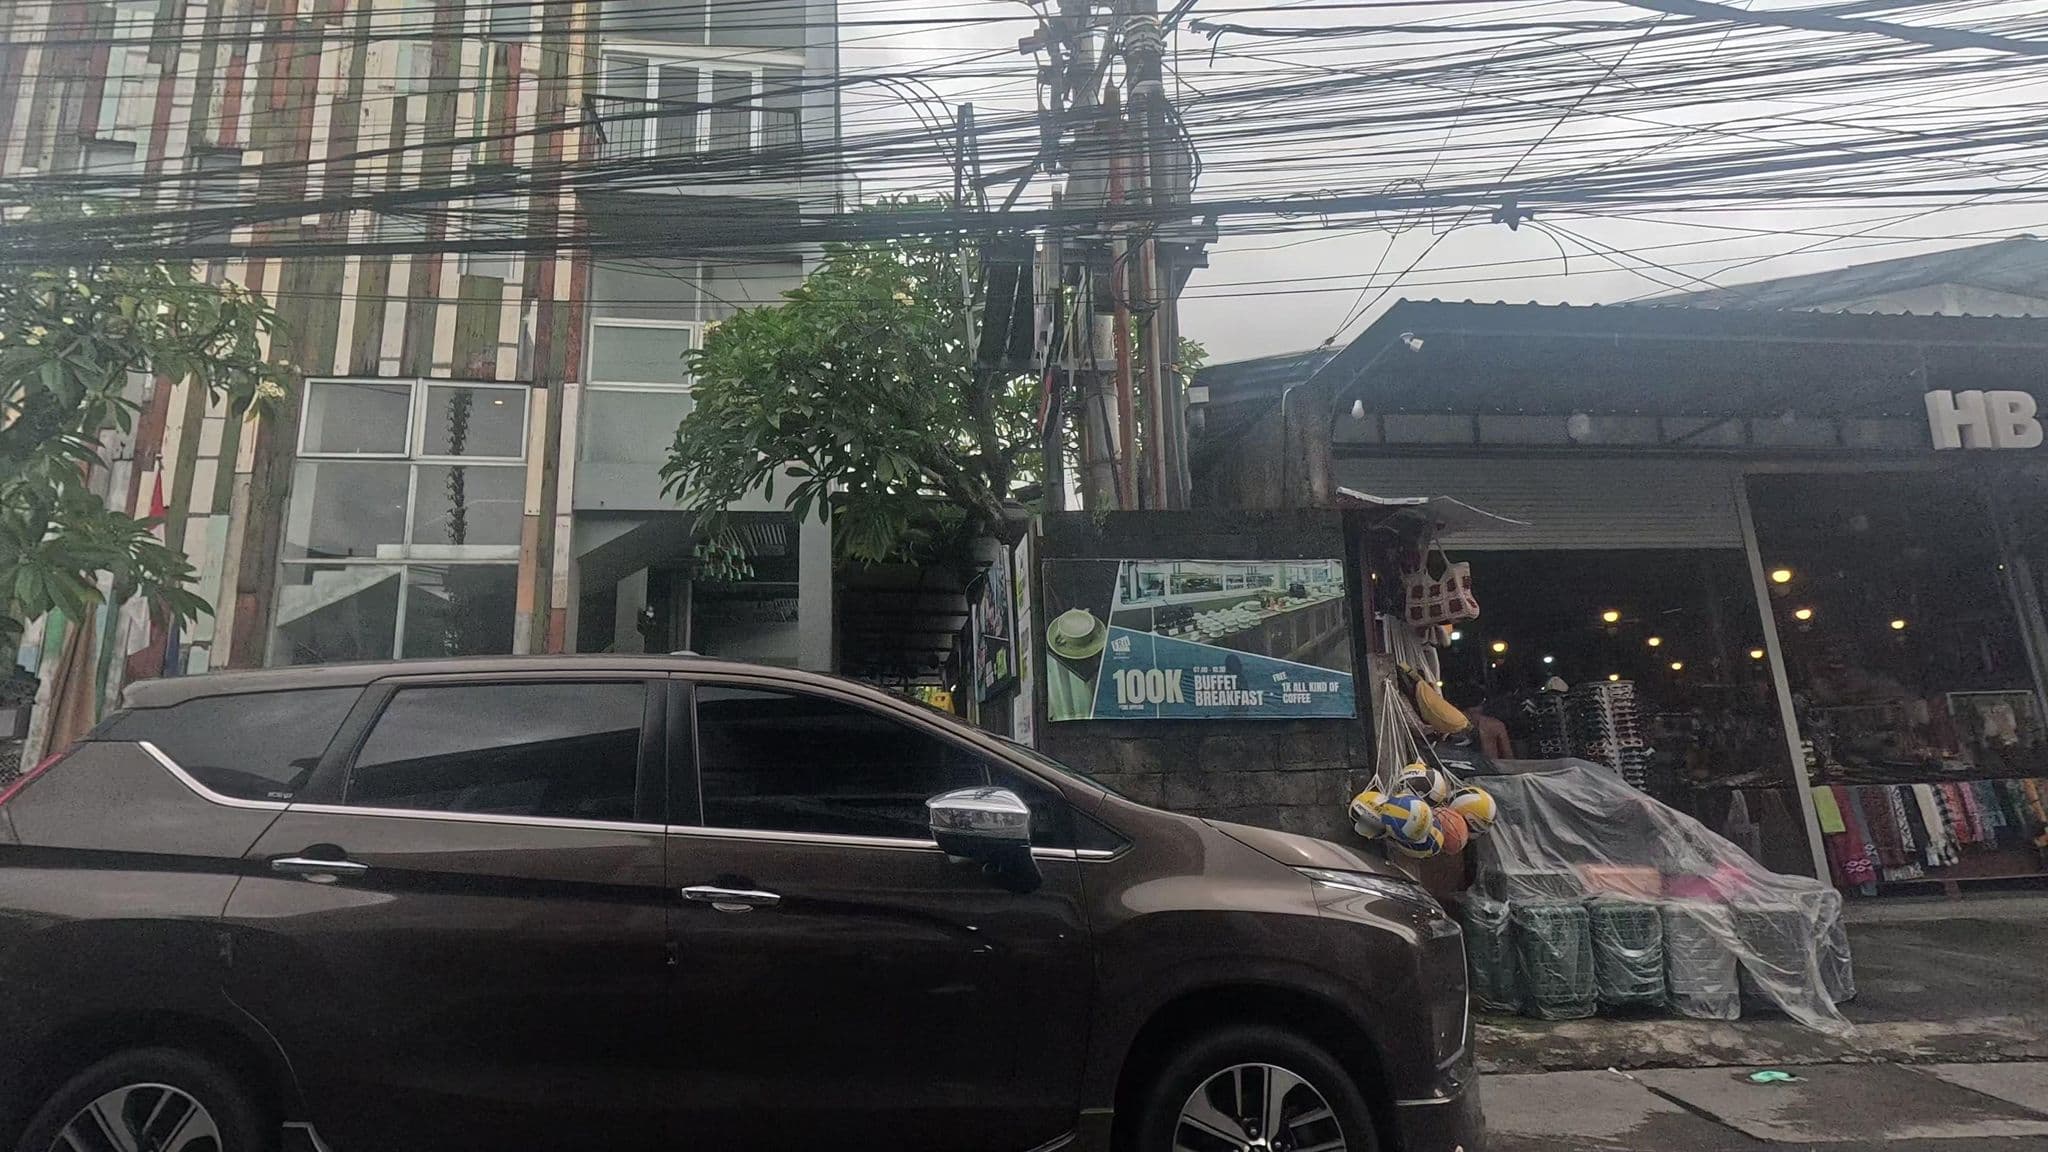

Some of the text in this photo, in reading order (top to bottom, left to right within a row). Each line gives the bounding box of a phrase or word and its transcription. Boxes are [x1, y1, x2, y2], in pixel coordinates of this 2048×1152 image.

[1924, 389, 2044, 450] HB
[1112, 668, 1185, 704] 100K
[1194, 674, 1238, 690] BUFFET
[1293, 682, 1308, 692] ALL
[1309, 682, 1328, 692] KIND
[1329, 682, 1340, 693] OF
[1195, 690, 1264, 706] BREAKFAST
[1283, 693, 1312, 704] COFFEE
